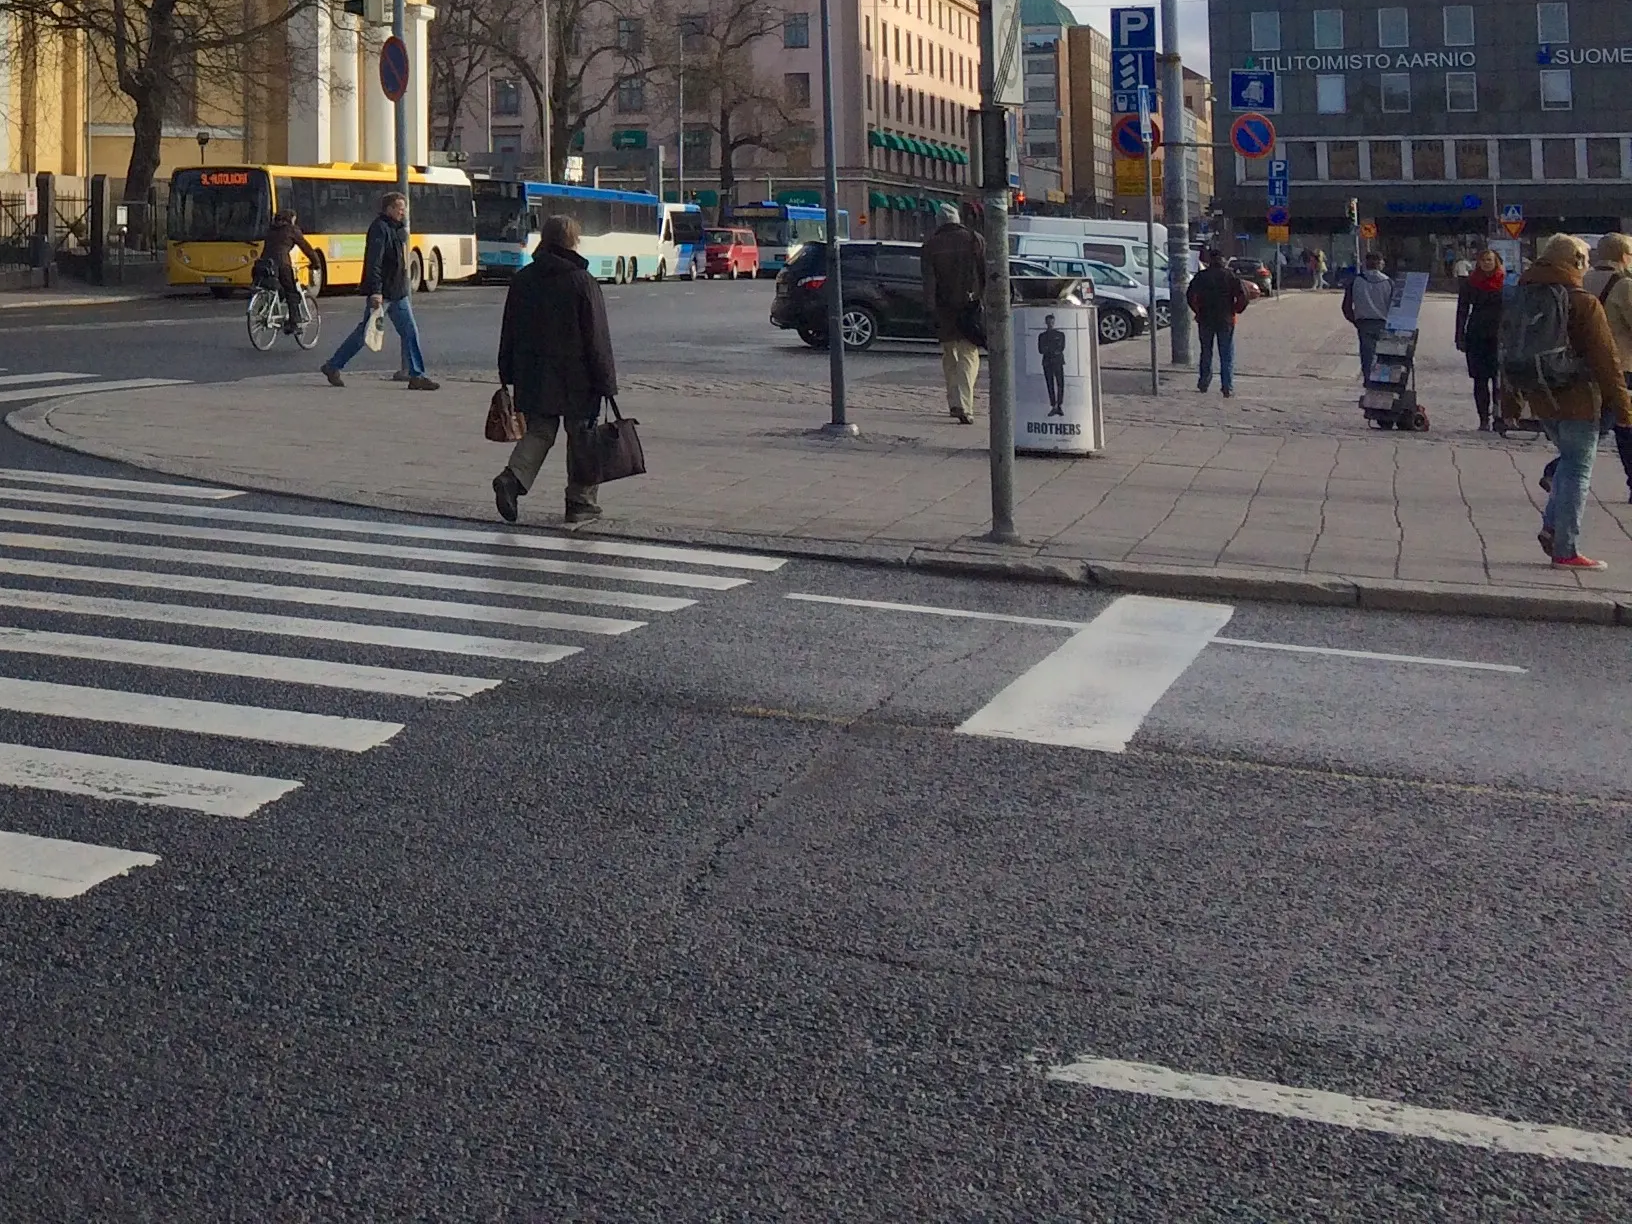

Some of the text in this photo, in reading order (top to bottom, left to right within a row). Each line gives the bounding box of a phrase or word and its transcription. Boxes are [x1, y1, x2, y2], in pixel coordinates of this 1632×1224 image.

[1119, 10, 1149, 46] P
[1259, 51, 1476, 71] TILITOIMISTO AARNIO
[1555, 47, 1632, 64] SUOME
[1271, 161, 1285, 177] P
[1027, 421, 1081, 435] BROTHERS
